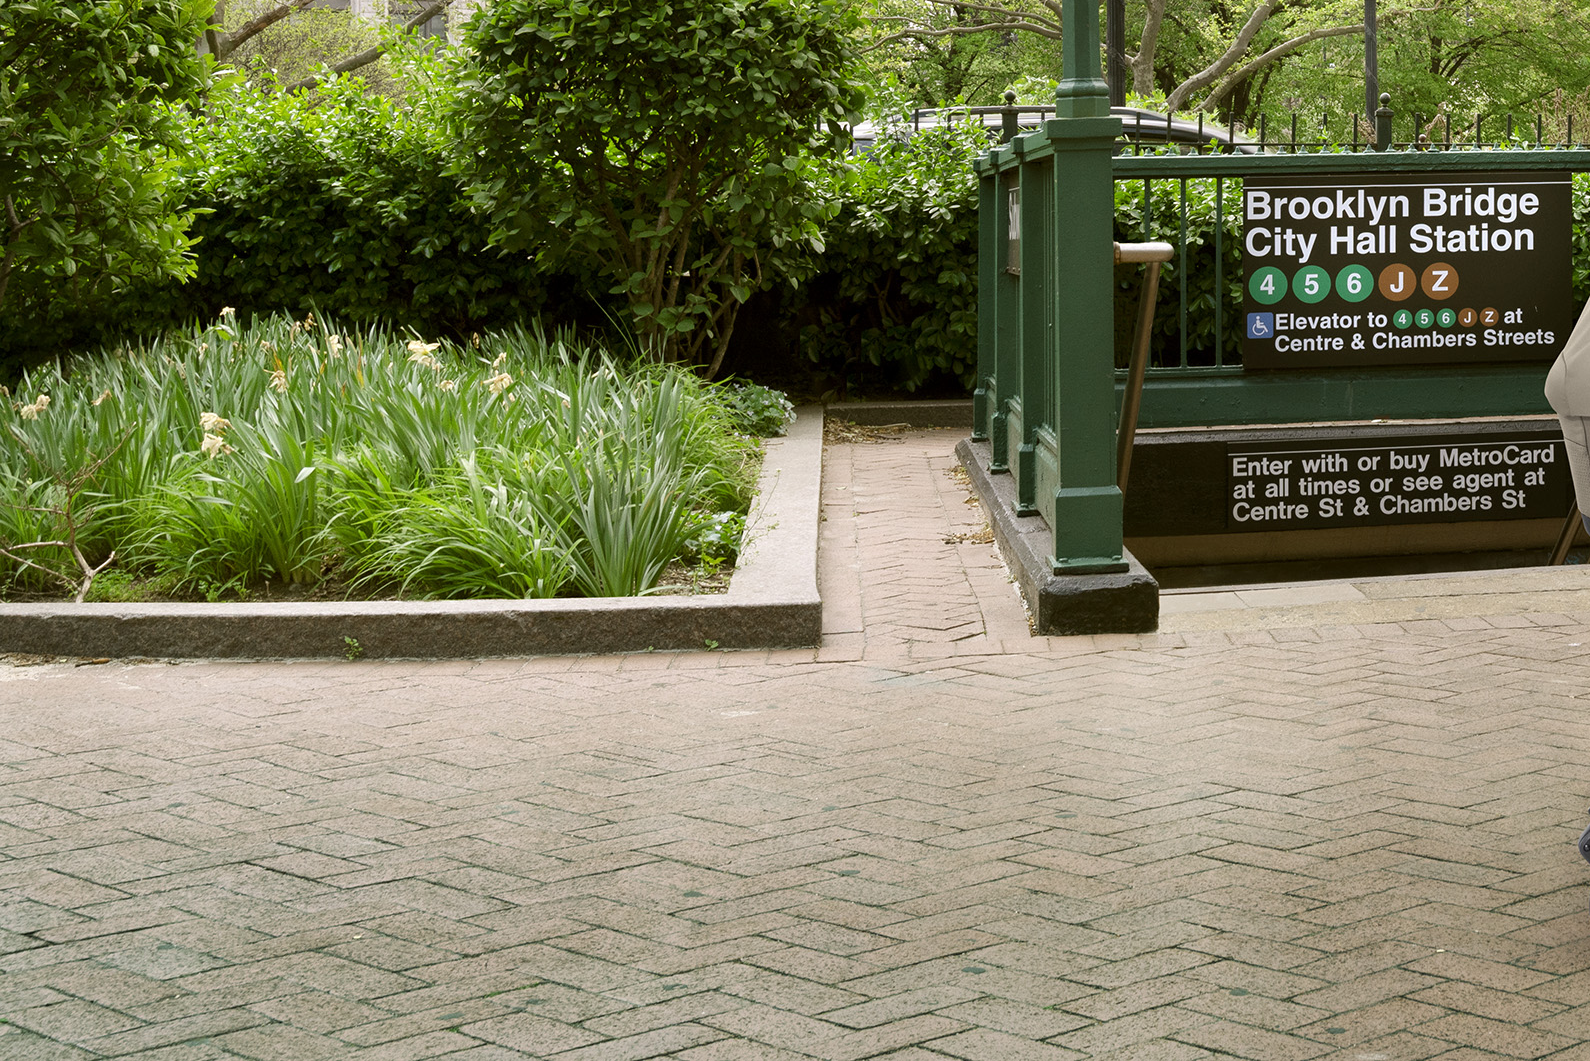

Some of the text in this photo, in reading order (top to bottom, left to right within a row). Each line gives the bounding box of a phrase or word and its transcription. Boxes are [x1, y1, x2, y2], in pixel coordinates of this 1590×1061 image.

[1247, 187, 1540, 226] Brooklyn Bridge
[1245, 222, 1534, 264] City Hall Station
[1259, 270, 1449, 296] 4 5 6 J Z
[1275, 312, 1362, 330] Elevator
[1366, 311, 1388, 328] to
[1503, 307, 1523, 324] at
[1274, 328, 1555, 353] Centre & Chambers Streets
[1232, 443, 1555, 477] Enter with or buy MetroCard
[1233, 467, 1546, 500] at all times or see agent at
[1232, 489, 1526, 522] Centre St & Chambers St
